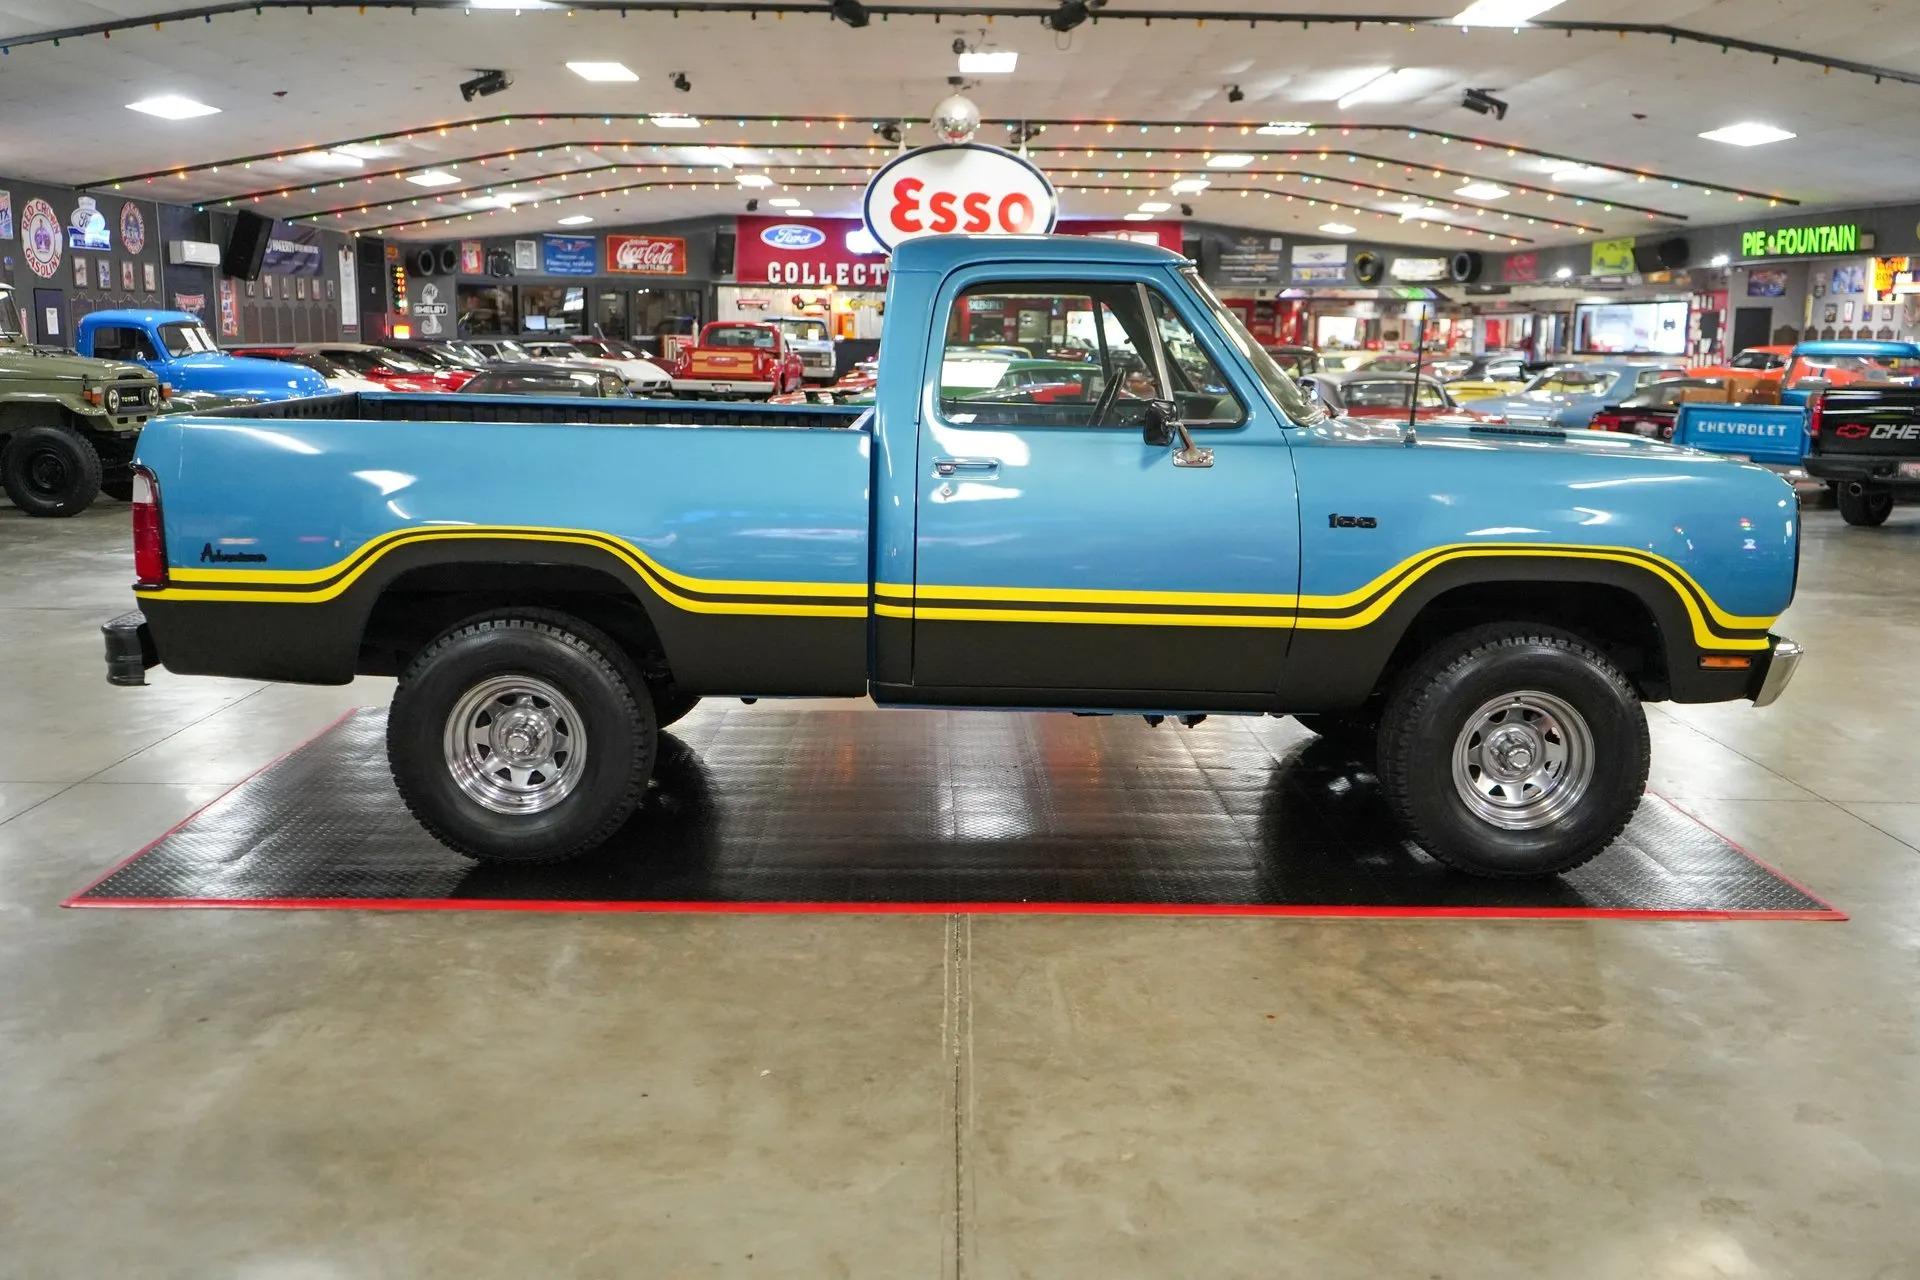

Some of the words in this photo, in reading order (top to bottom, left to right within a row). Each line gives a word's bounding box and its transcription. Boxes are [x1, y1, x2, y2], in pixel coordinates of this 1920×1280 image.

[23, 204, 35, 231] RED
[35, 200, 60, 234] CROWN
[773, 228, 812, 244] Ford
[1742, 230, 1766, 256] PIE
[1777, 224, 1856, 255] FOUNTAIN
[25, 247, 62, 277] GASOLINE
[617, 240, 675, 265] Coca-Cola
[415, 305, 445, 314] SHELBY
[1698, 420, 1788, 437] CHEVROLET
[1870, 424, 1920, 439] CHE
